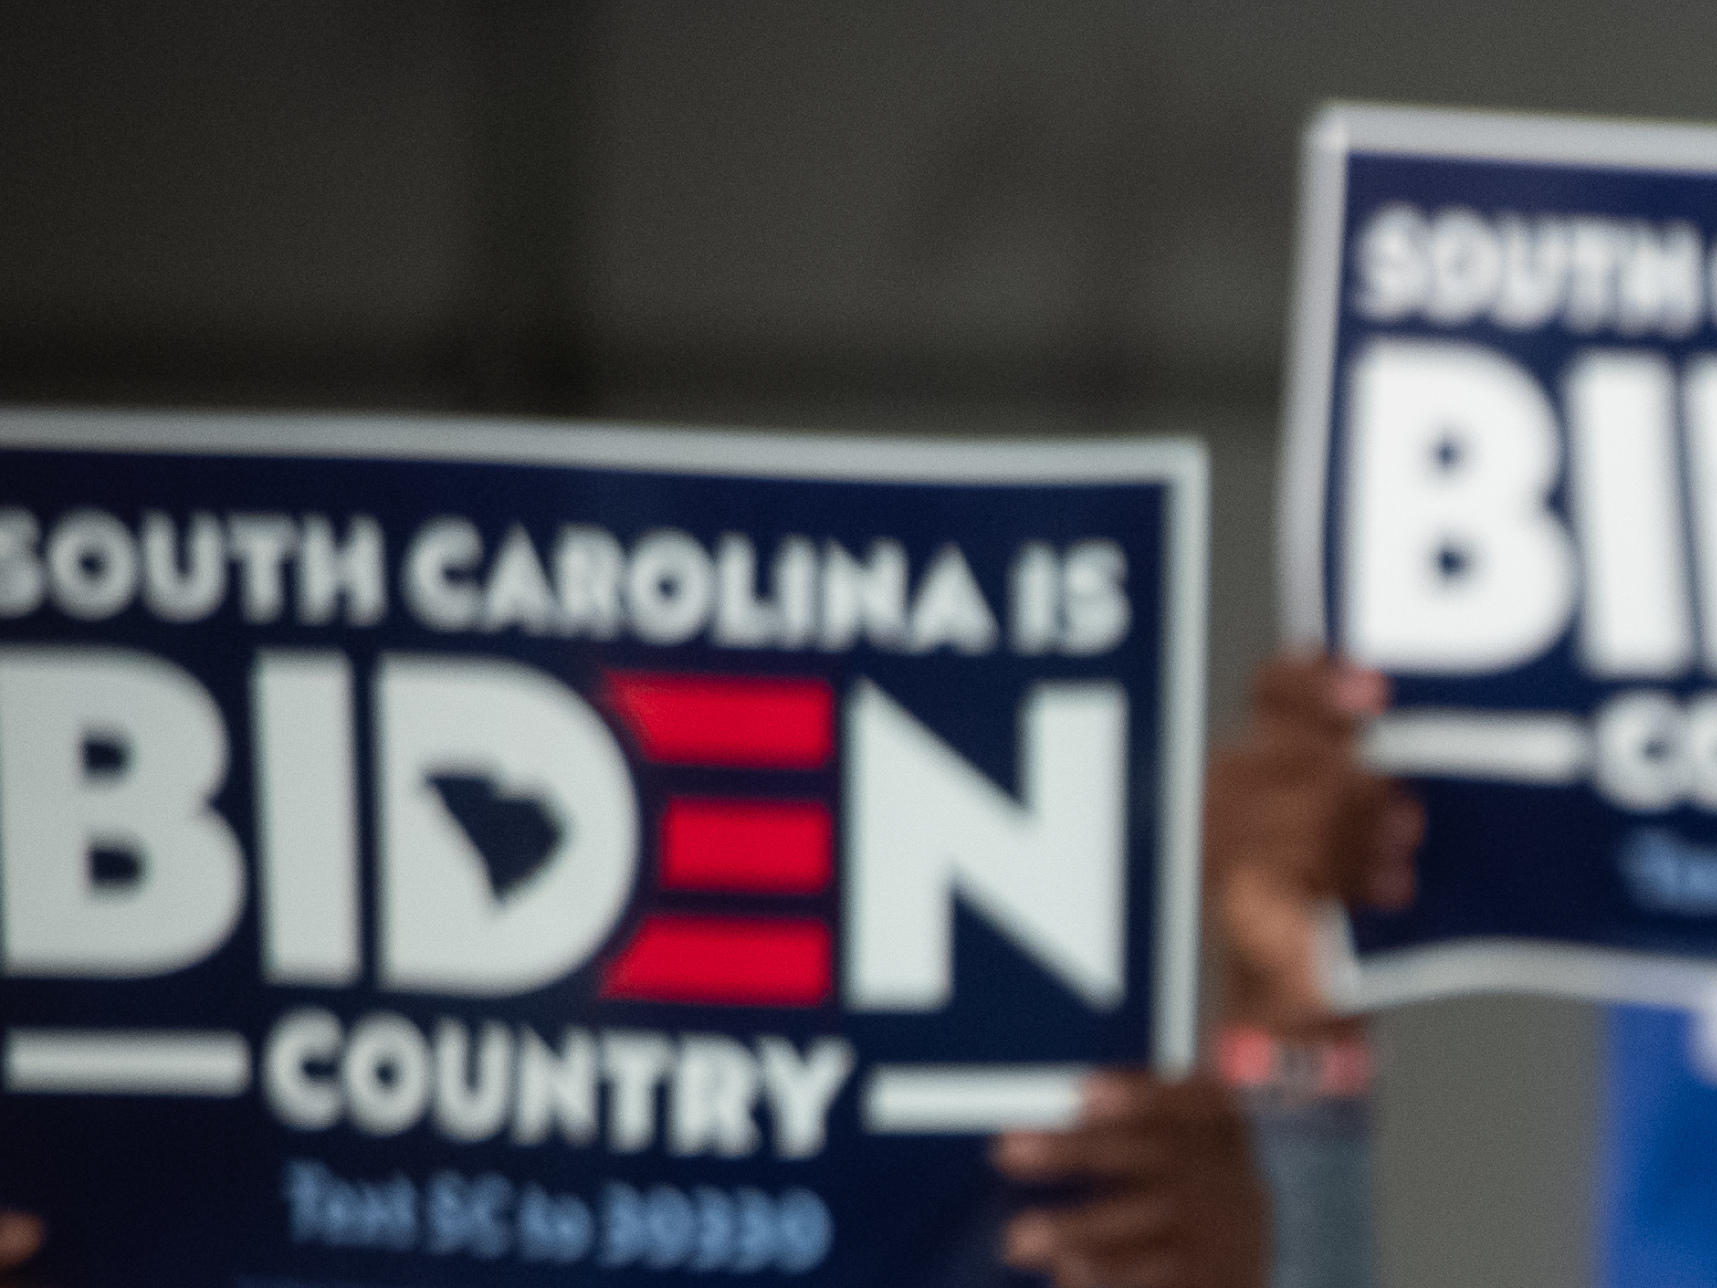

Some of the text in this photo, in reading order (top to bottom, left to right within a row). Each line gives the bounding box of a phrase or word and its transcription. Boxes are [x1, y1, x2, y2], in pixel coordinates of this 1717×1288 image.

[1355, 208, 1700, 330] SOUTH
[402, 514, 1000, 657] CAROLINA
[1008, 540, 1132, 657] IS
[0, 643, 1130, 1012] BIDEN
[264, 1008, 854, 1160] COUNTRY
